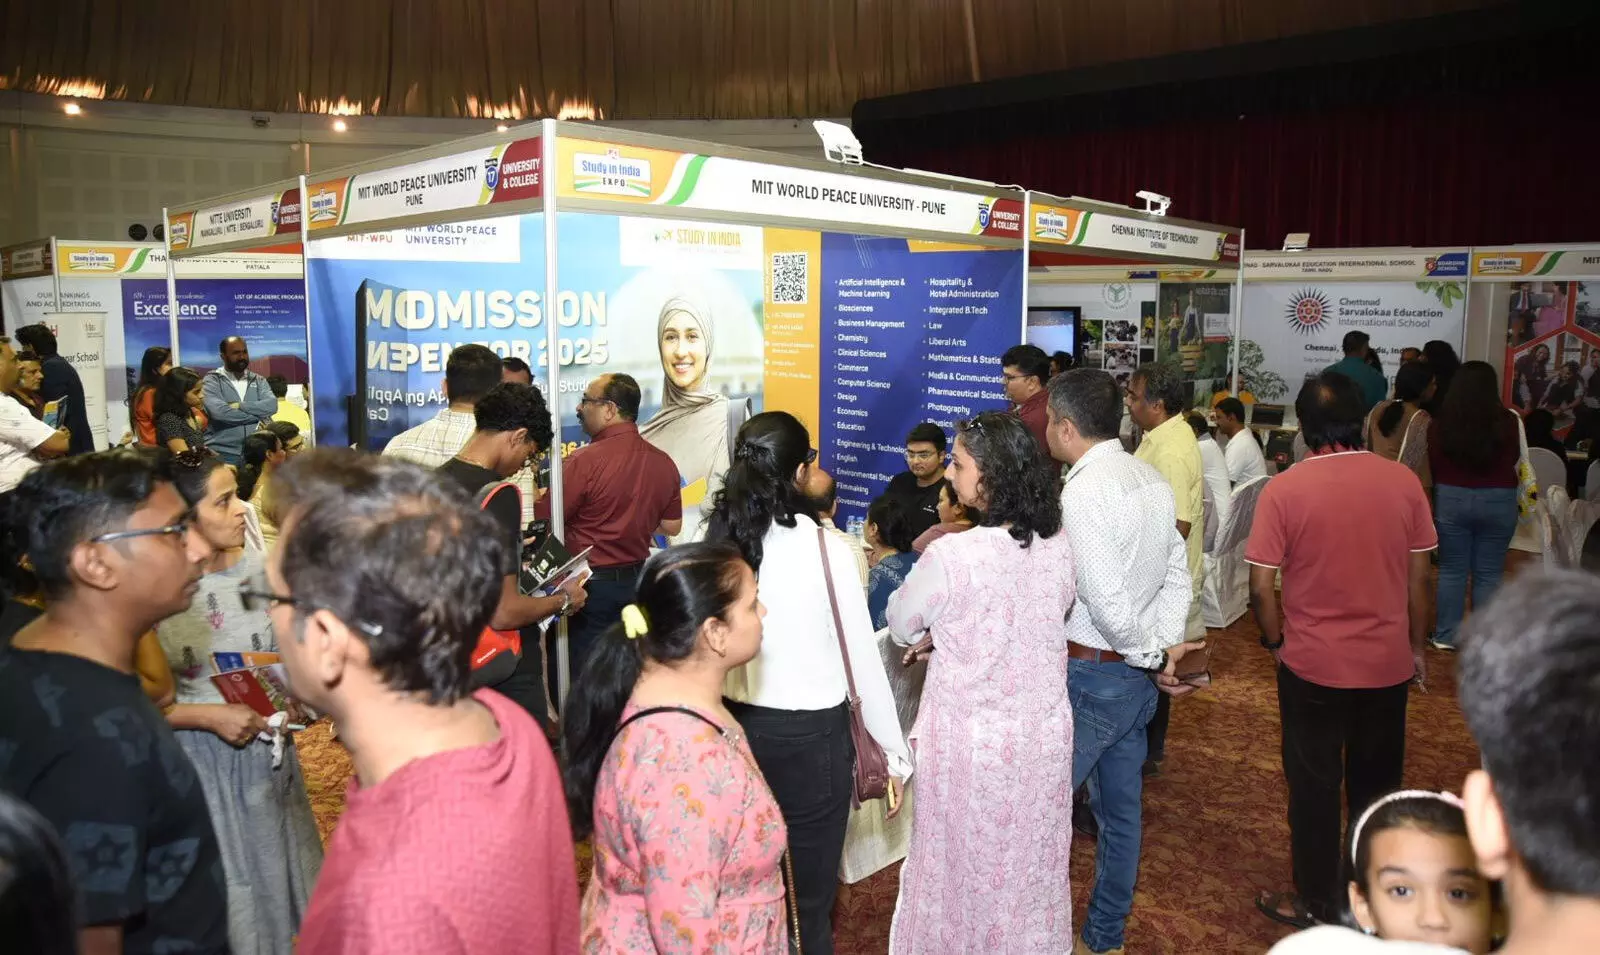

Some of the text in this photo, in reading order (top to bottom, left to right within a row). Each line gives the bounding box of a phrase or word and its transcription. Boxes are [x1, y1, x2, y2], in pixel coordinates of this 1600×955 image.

[502, 158, 540, 175] UNIVERSITY
[582, 160, 640, 176] Study in India
[488, 170, 496, 183] 17
[503, 173, 539, 189] & COLLEGE
[603, 177, 625, 187] EXPO
[358, 165, 478, 200] MIT WORLD PEACE UNIVERSITY
[406, 193, 423, 206] PUNE
[752, 179, 774, 195] MIT
[776, 182, 819, 200] WORLD
[822, 188, 857, 205] PEACE
[859, 192, 915, 212] UNIVERSITY
[921, 200, 946, 215] PUNE
[210, 207, 252, 225] NITTE UNIVERSITY
[992, 210, 1021, 222] UNIVERSITY
[426, 224, 463, 234] WORLD
[466, 226, 497, 236] PEACE
[997, 221, 1019, 231] COLLEGE
[677, 228, 741, 247] STUDY IN INDIA
[1112, 224, 1199, 244] CHENNAI INSTITUTE OF TECHNOLOGY
[406, 235, 467, 245] UNIVERSITY
[838, 279, 864, 287] Artificial
[864, 279, 900, 287] Intelligence
[929, 278, 973, 287] Hospitality &
[60, 291, 90, 299] ANKINGS
[838, 290, 890, 299] Machine Learning
[929, 289, 1000, 299] Hotel Administration
[1339, 297, 1381, 306] Chettinad
[134, 300, 217, 316] Excelence
[838, 304, 874, 313] Biosciences
[929, 306, 988, 315] Integrated B.Tech
[1339, 307, 1444, 318] Sarvalokaa Education
[838, 319, 905, 330] Business Management
[1339, 318, 1430, 328] International School
[837, 334, 868, 344] Chemistry
[928, 337, 967, 346] Liberal Arts
[538, 336, 610, 366] 2025
[837, 348, 887, 358] Clinical Sciences
[1304, 343, 1340, 353] Chennai,
[77, 350, 99, 363] School
[928, 353, 971, 363] Mathematics
[972, 355, 979, 364] &
[837, 364, 869, 372] Commerce
[928, 371, 949, 381] Media
[949, 372, 955, 380] &
[837, 378, 891, 389] Computer Science
[837, 392, 857, 403] Design
[927, 387, 980, 399] Pharmaceutical
[837, 407, 868, 417] Economics
[927, 402, 971, 416] Photography
[837, 422, 866, 432] Education
[836, 438, 871, 452] Engineering
[871, 442, 877, 451] &
[836, 453, 858, 463] English
[836, 467, 878, 481] Environmental
